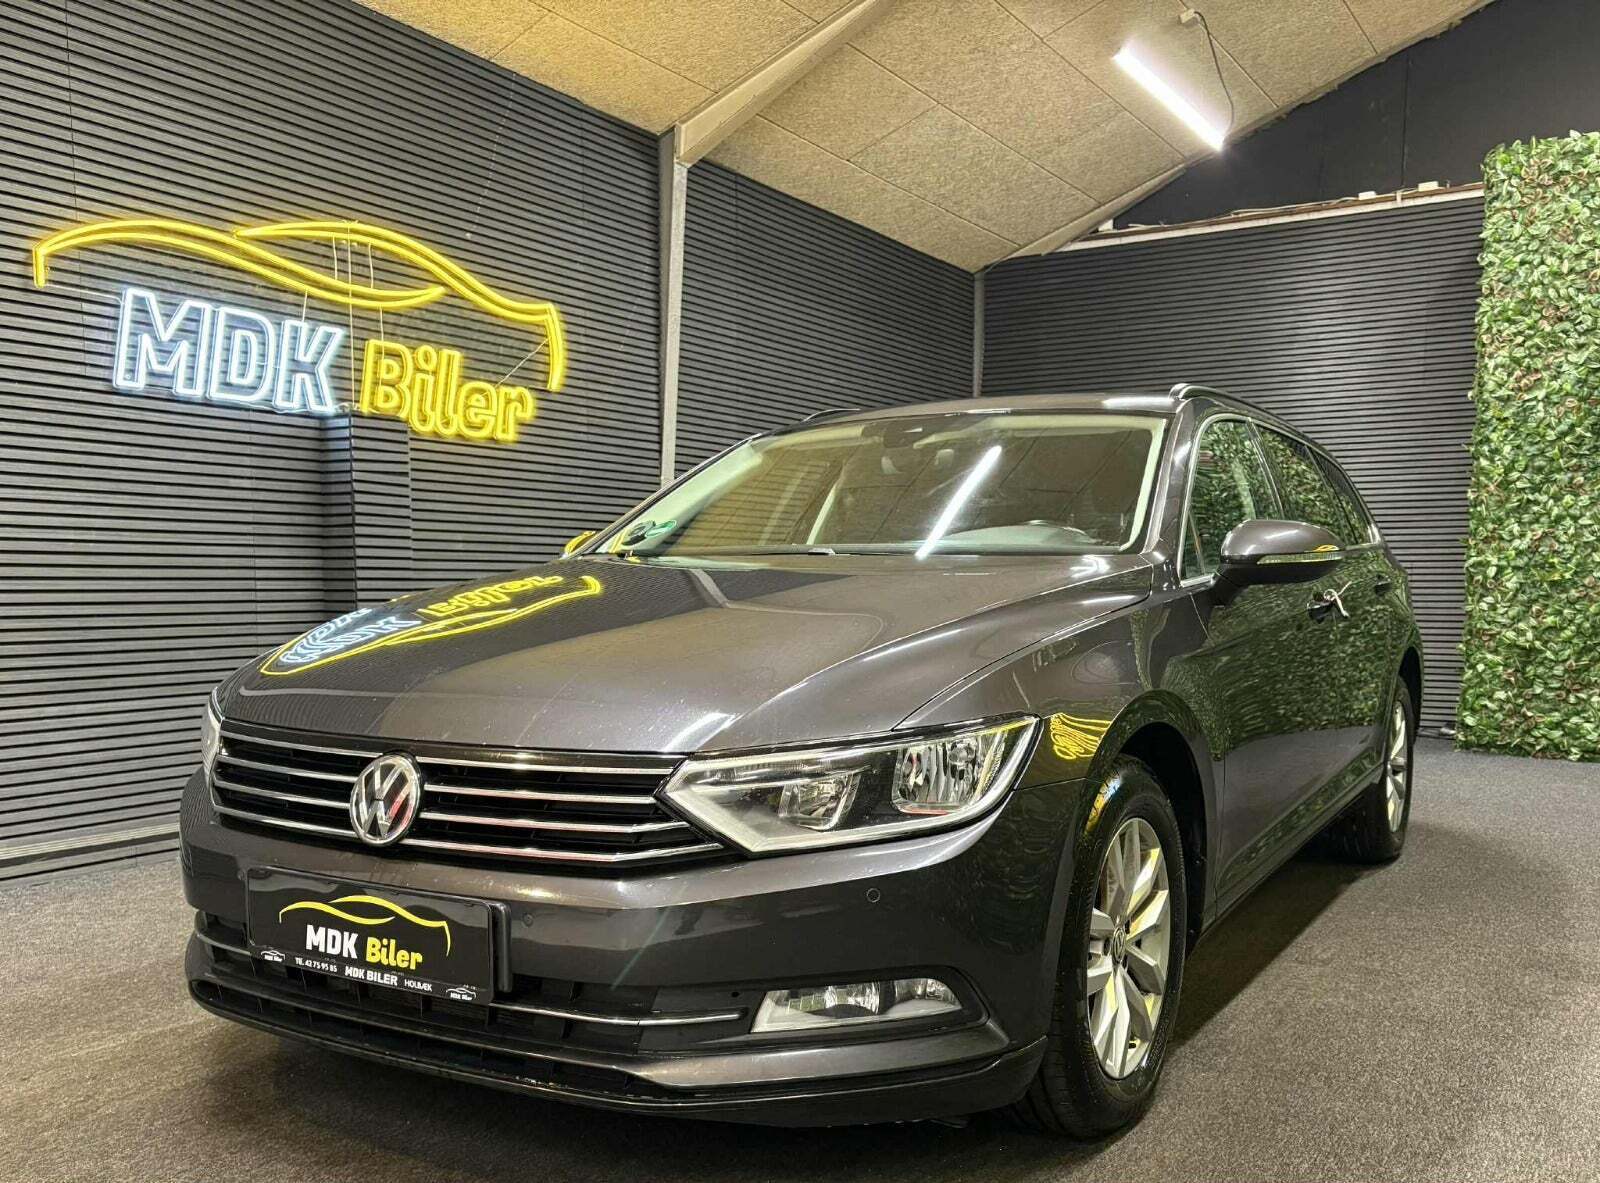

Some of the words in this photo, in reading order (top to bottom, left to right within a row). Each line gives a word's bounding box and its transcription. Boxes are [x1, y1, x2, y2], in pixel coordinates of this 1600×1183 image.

[112, 287, 346, 414] MDK
[361, 338, 536, 442] Biler
[305, 924, 358, 959] MDK
[366, 936, 423, 970] Biler
[344, 965, 365, 980] MDK
[366, 970, 398, 986] BILER
